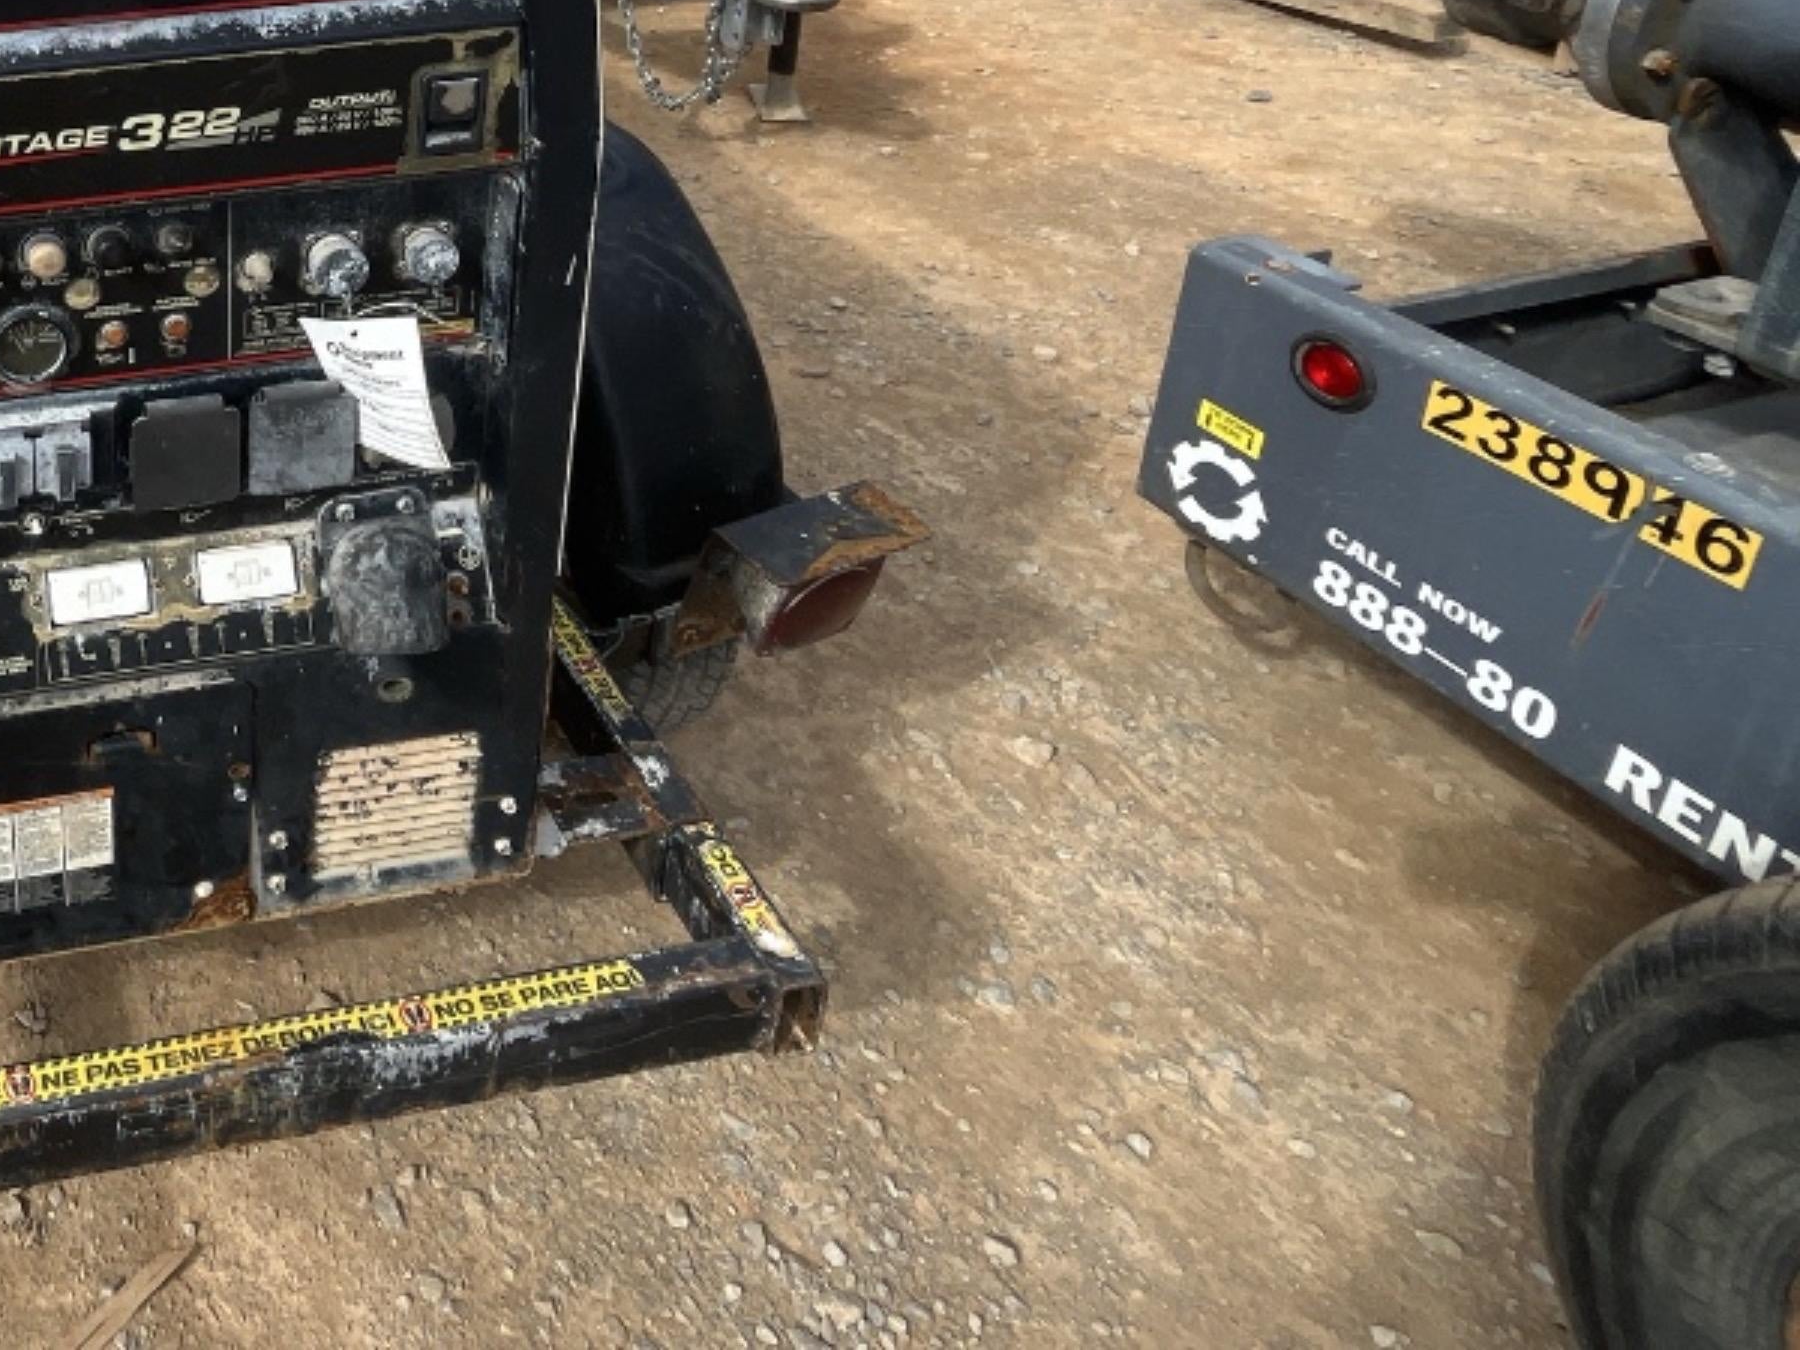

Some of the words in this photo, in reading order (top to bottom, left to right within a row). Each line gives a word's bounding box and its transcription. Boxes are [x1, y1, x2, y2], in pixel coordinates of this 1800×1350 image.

[117, 106, 241, 152] 322
[1428, 387, 1750, 576] 238946
[1325, 527, 1402, 588] CALL
[1417, 581, 1503, 643] NOW
[434, 998, 476, 1020] NO
[479, 990, 516, 1012] SE
[519, 977, 591, 1004] PARE
[40, 1069, 80, 1091] NE
[86, 1057, 142, 1085] PAS
[146, 1040, 238, 1073] TENEZ
